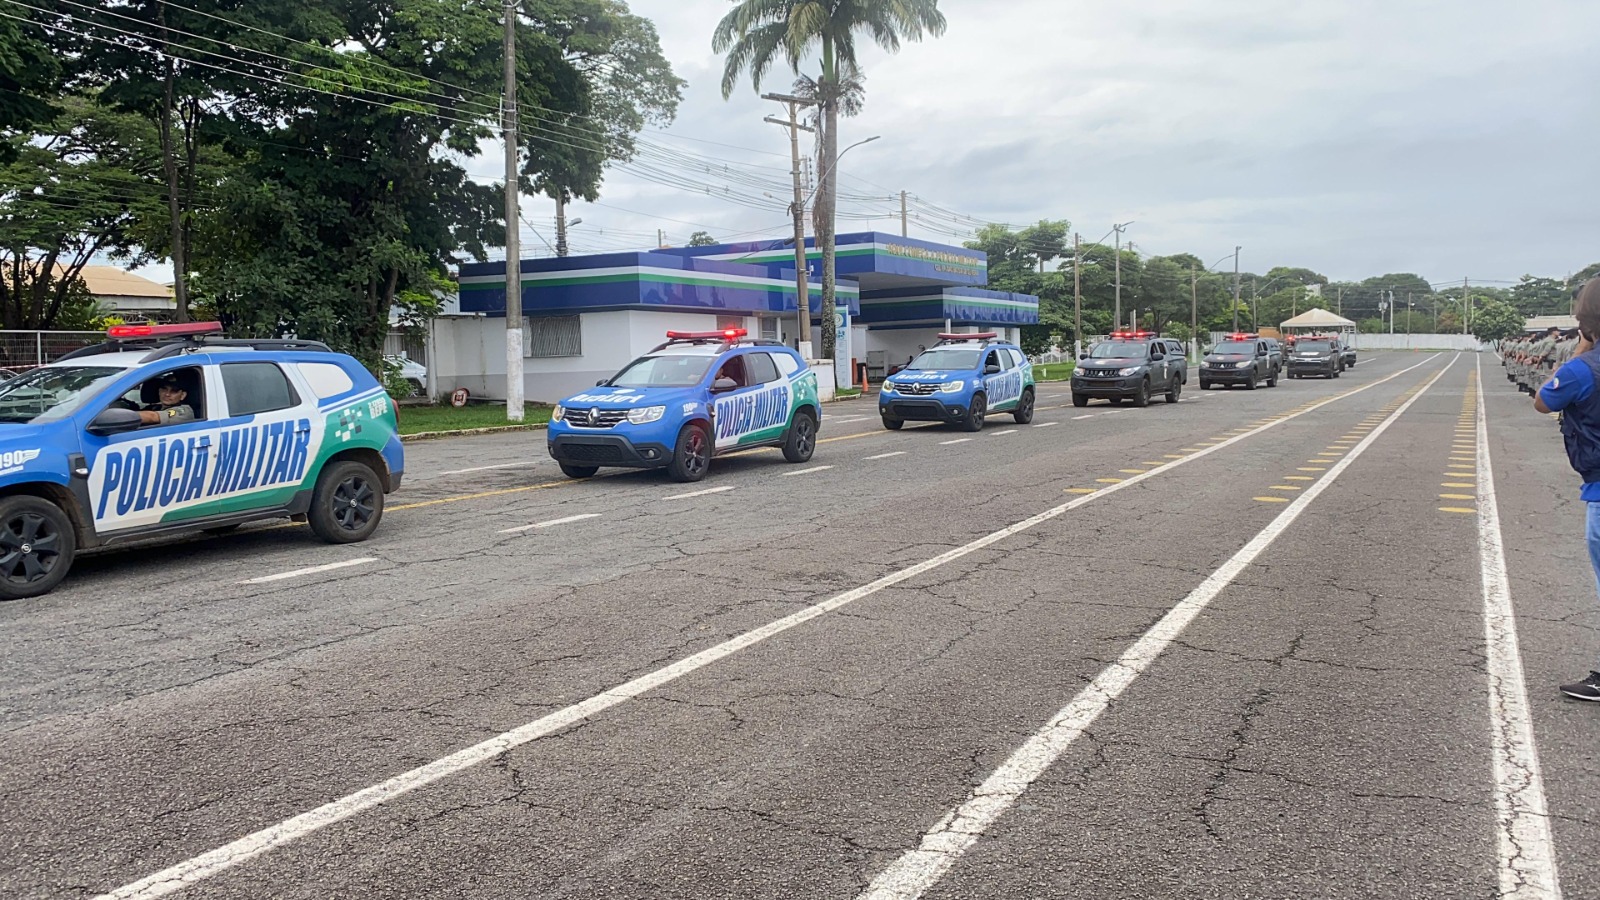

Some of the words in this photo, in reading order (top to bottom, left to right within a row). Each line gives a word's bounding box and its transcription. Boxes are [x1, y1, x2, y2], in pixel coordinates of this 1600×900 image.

[715, 395, 753, 440] POLÍCIA
[751, 386, 788, 431] MILITAR
[96, 435, 211, 519] POLÍCIA
[206, 418, 311, 496] MILITAR
